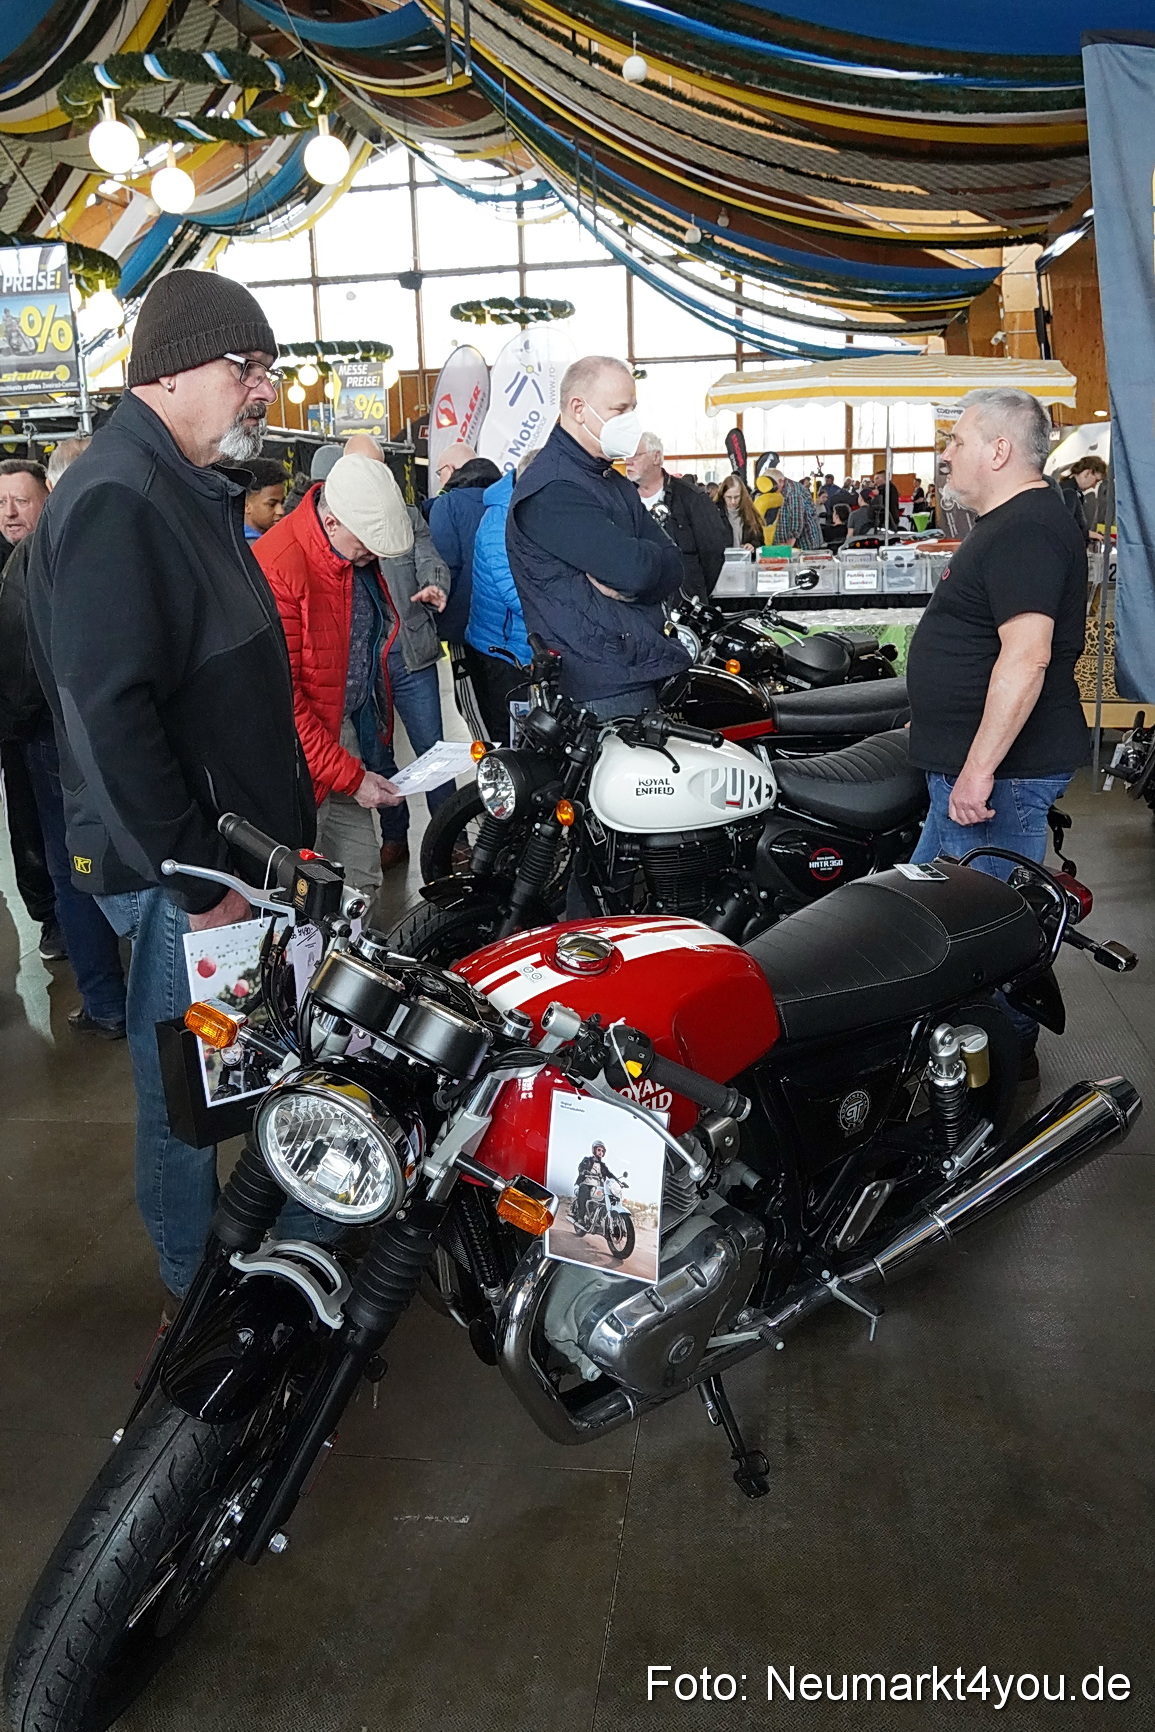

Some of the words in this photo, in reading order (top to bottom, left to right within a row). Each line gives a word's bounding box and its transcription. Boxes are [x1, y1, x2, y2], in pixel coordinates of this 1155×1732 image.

[2, 270, 61, 293] PREISE!
[338, 364, 368, 376] MESSE
[346, 375, 381, 387] PREISE!
[508, 410, 541, 458] Moto
[638, 777, 671, 787] ROYAL
[703, 767, 774, 808] PURE
[635, 786, 675, 797] ENFIELD
